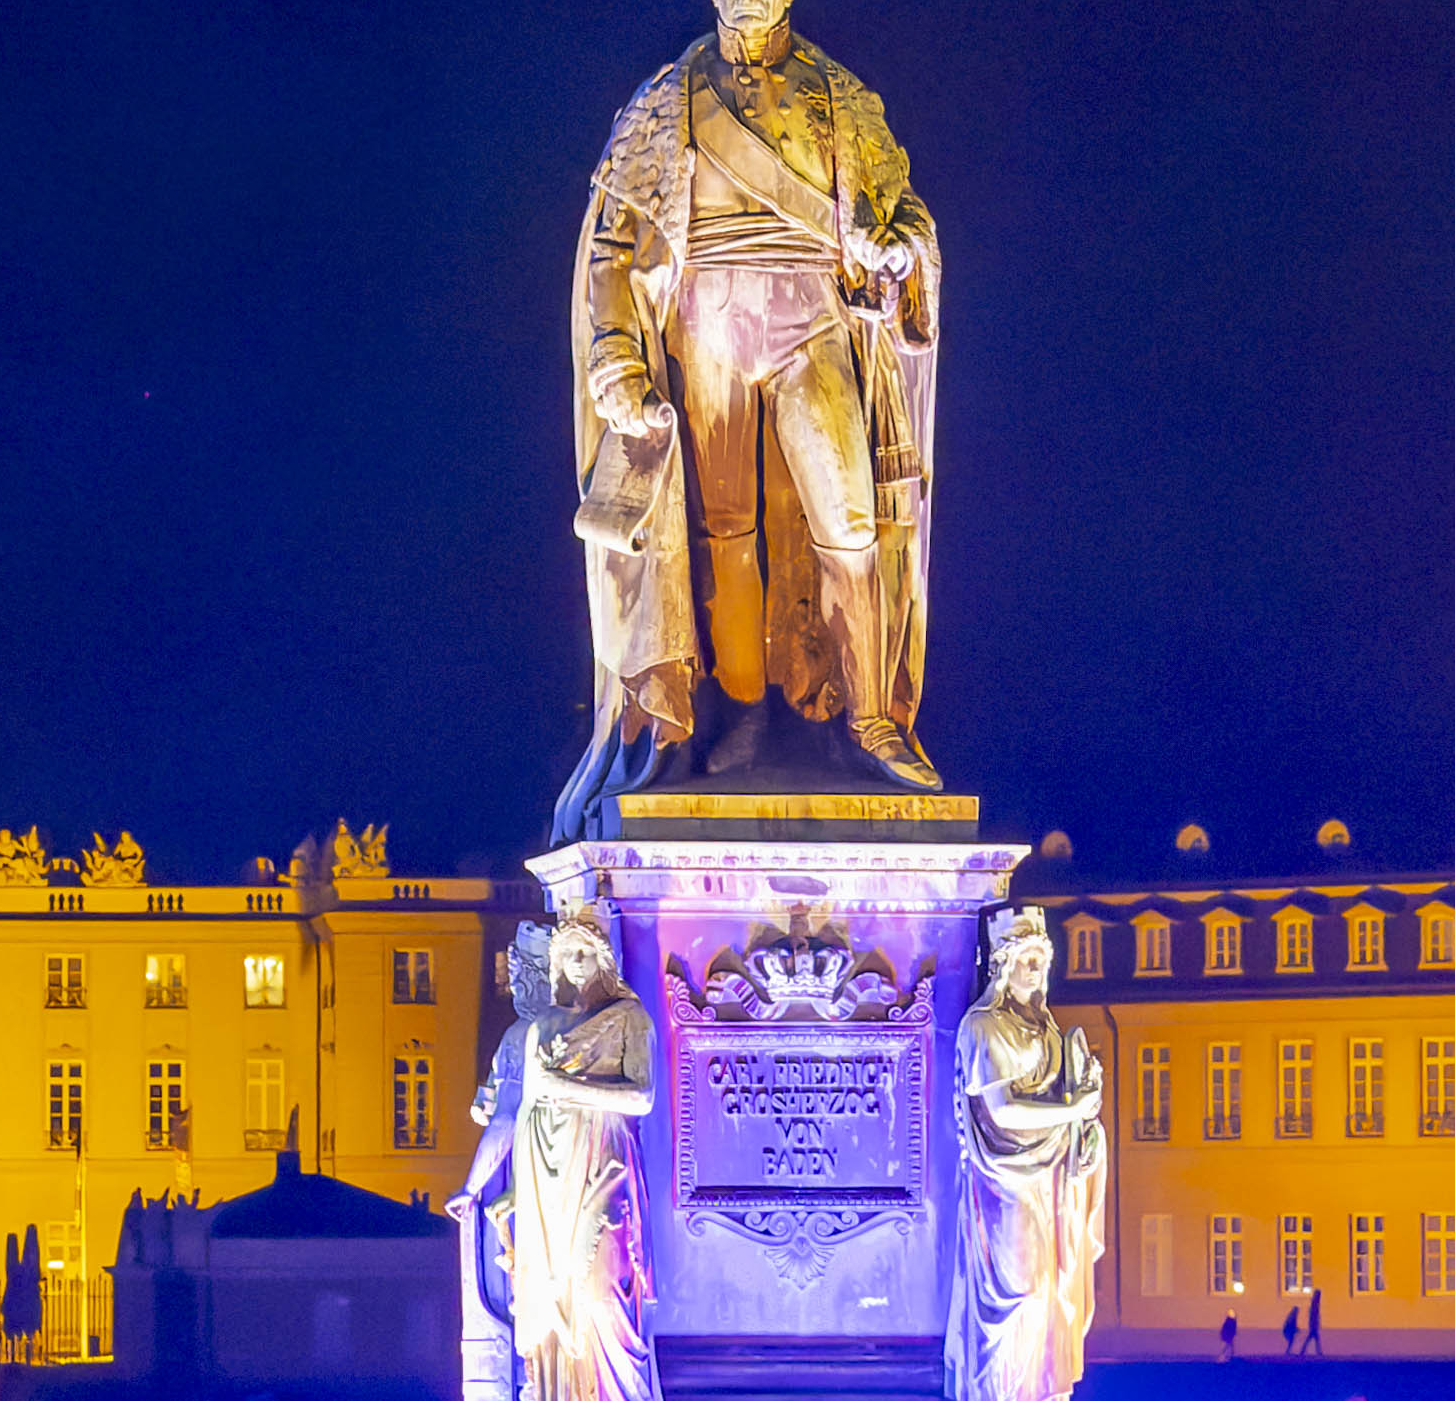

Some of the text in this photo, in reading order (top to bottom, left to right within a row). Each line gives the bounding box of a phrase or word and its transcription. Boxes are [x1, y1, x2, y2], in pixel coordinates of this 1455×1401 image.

[708, 1056, 894, 1087] CARL FRIEDRICH
[775, 1117, 826, 1147] VON
[762, 1147, 838, 1178] BADEN
